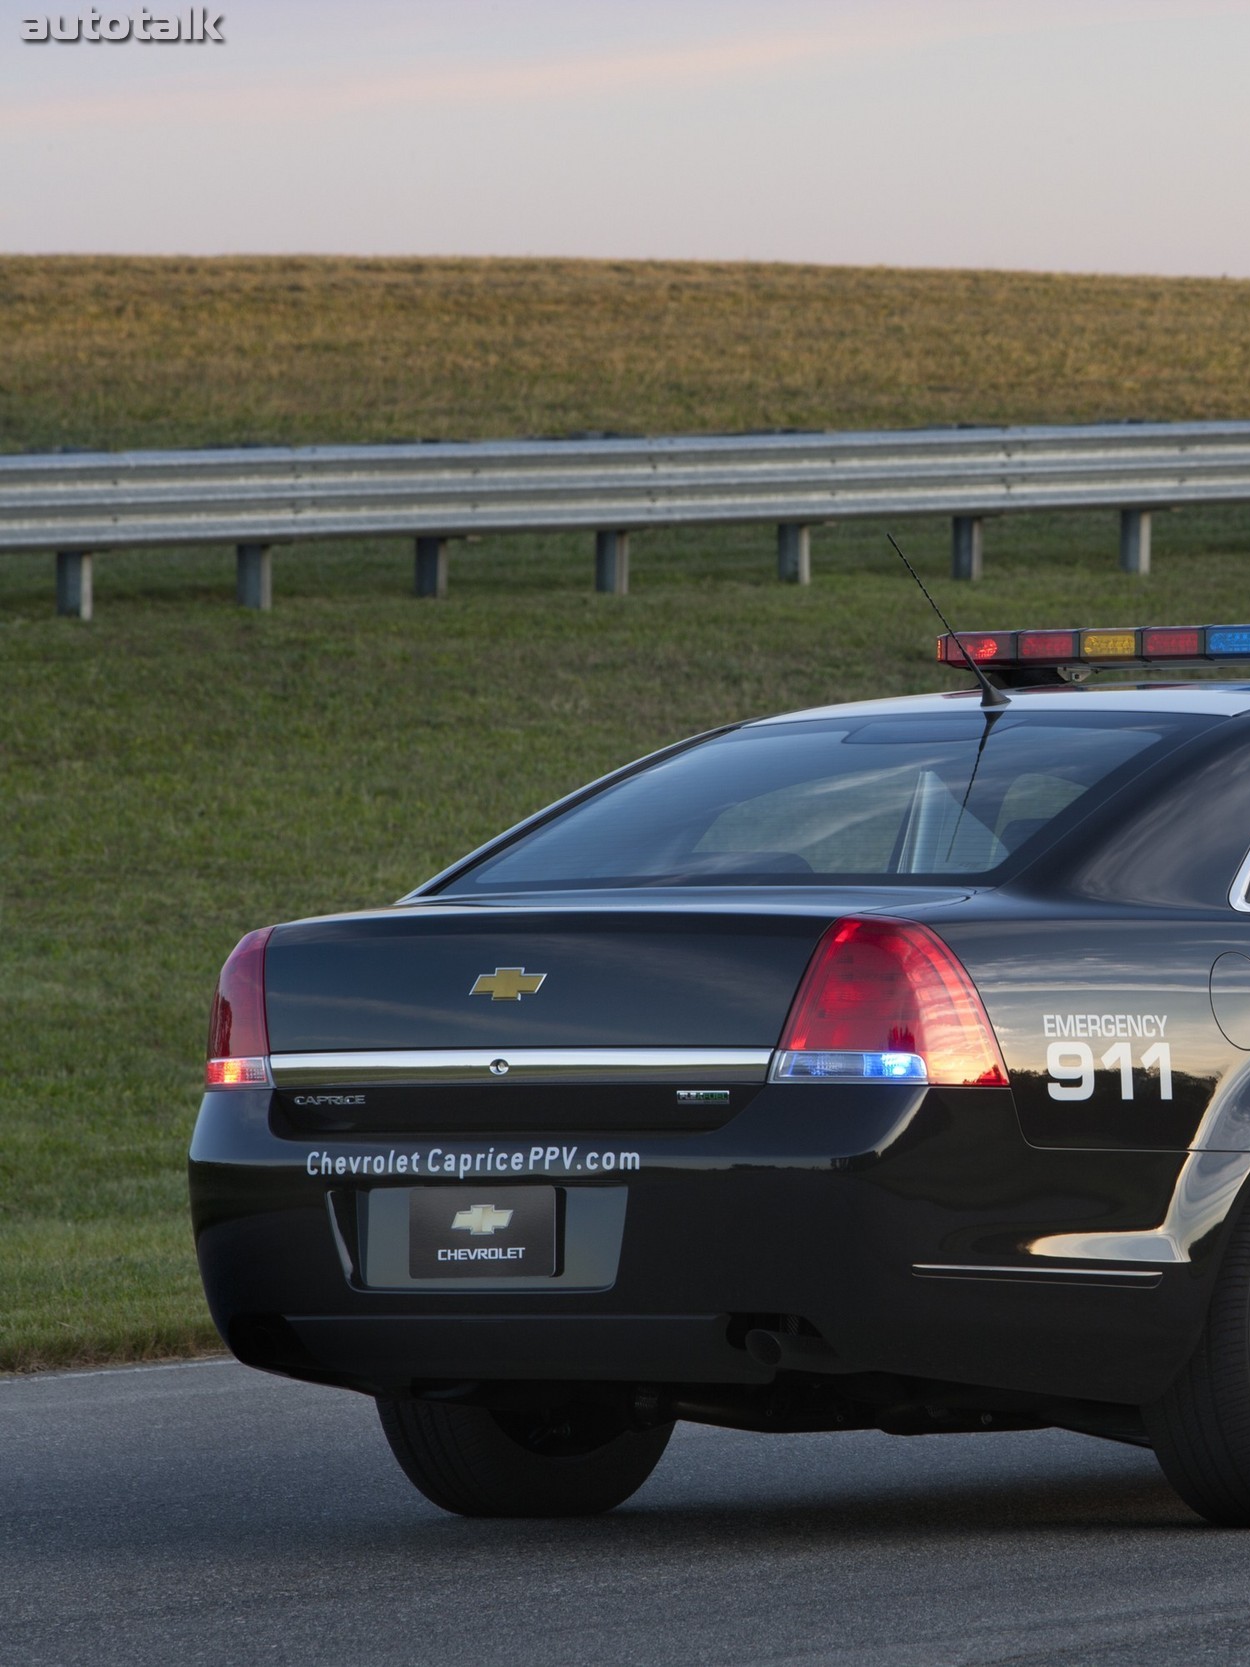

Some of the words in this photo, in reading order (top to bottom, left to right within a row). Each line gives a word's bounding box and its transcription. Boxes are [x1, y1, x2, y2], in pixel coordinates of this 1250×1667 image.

[1043, 1014, 1168, 1038] EMERGENCY
[1046, 1041, 1174, 1101] 911
[293, 1094, 367, 1106] CAPRICE
[437, 1246, 526, 1261] CHEVROLET
